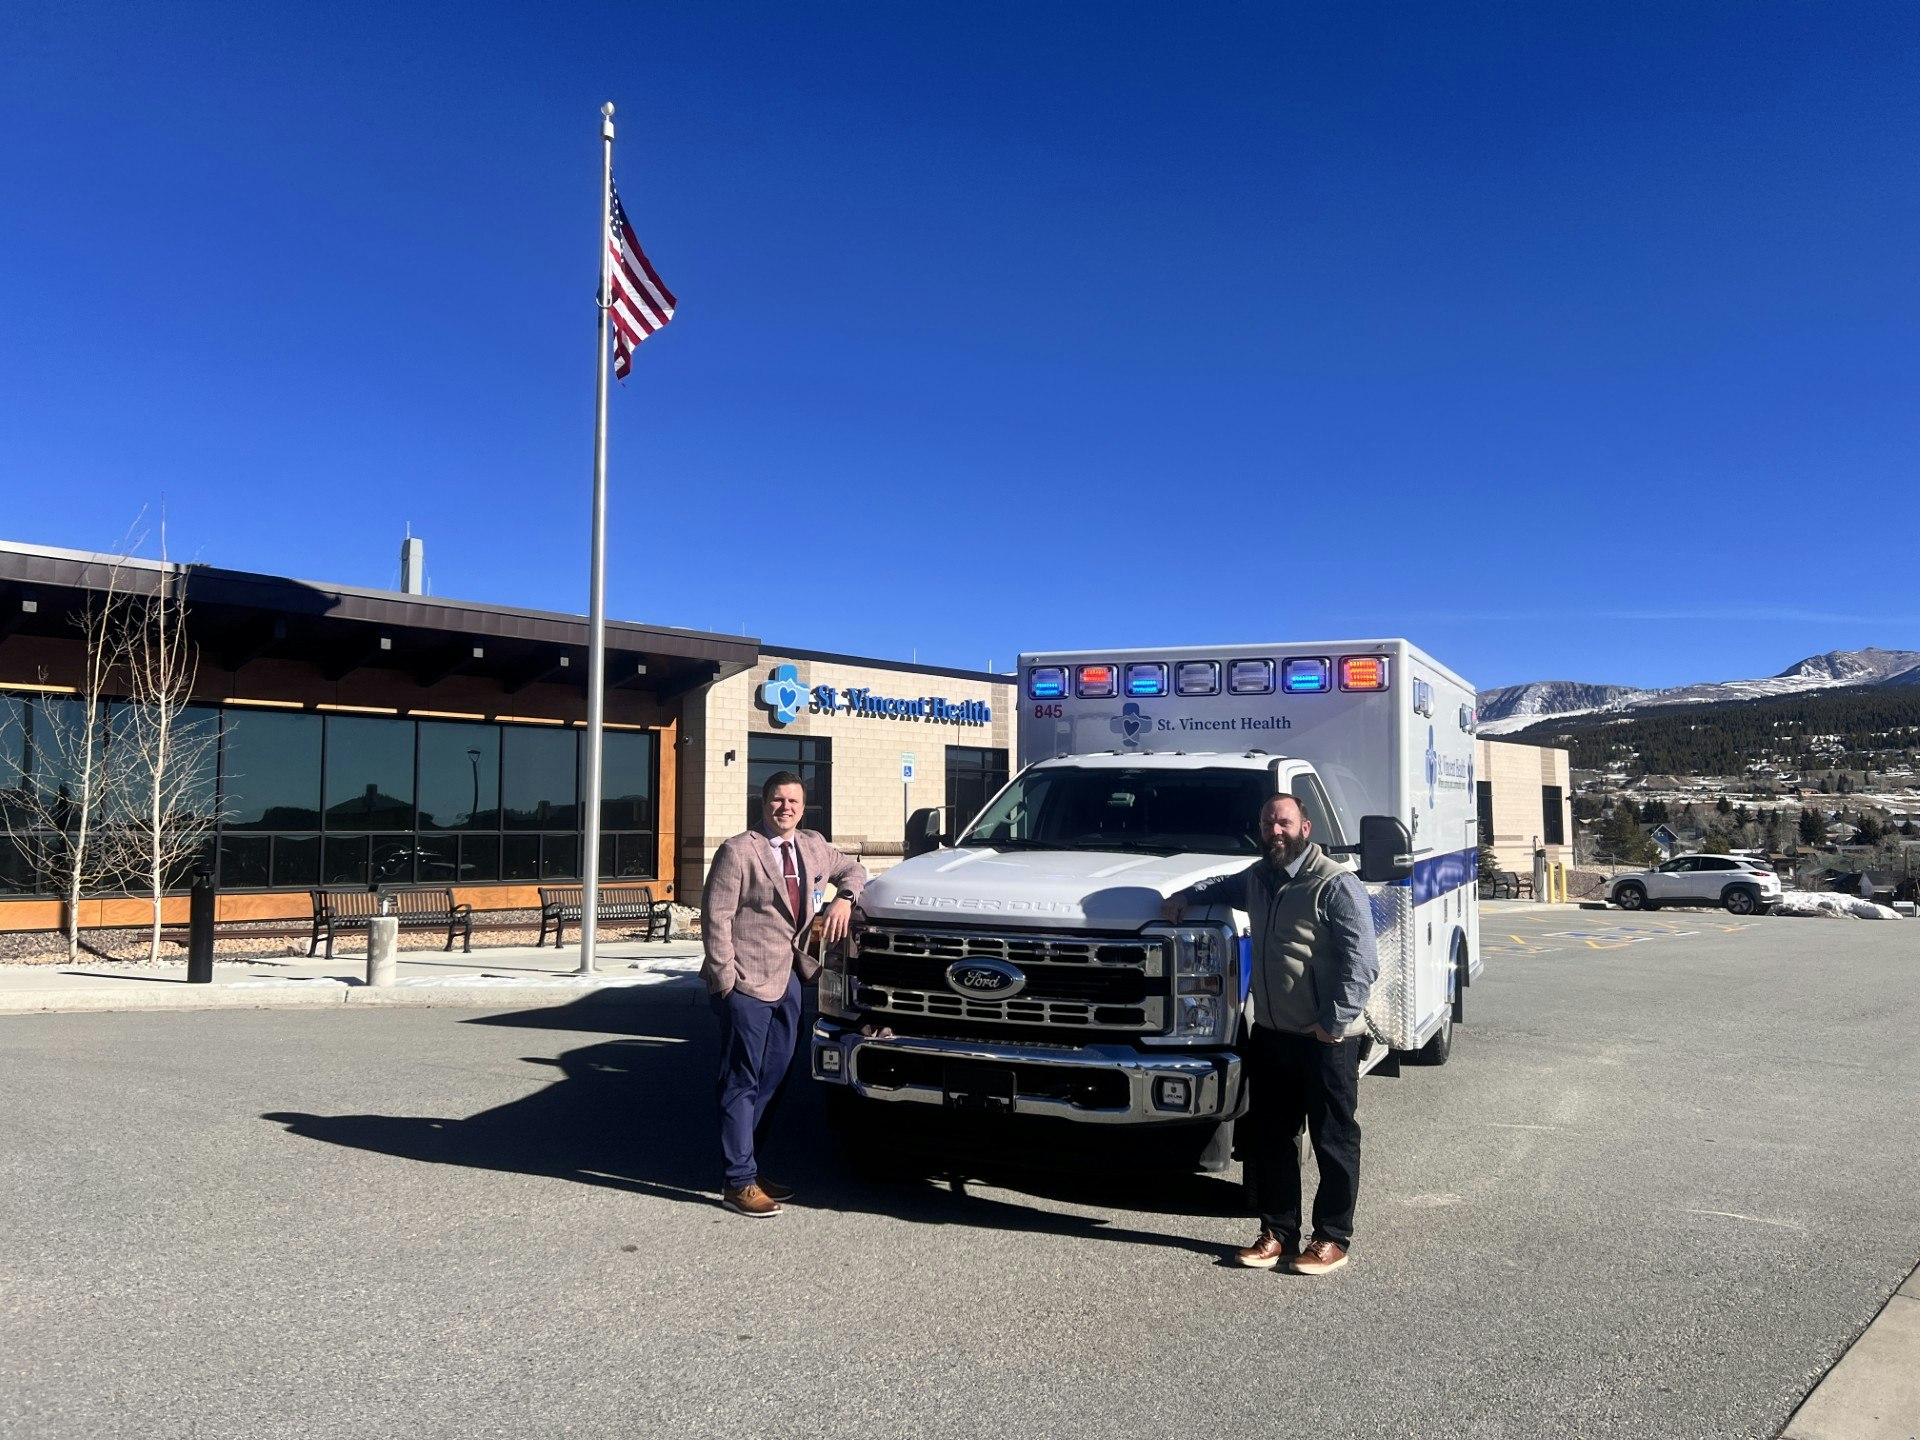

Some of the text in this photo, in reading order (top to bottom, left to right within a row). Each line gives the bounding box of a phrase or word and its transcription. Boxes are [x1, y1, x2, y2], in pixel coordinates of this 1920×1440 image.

[818, 684, 992, 723] St. Vincent Health
[1034, 704, 1063, 719] 845
[1157, 716, 1291, 731] St. Vincent Health
[894, 895, 1080, 913] SUPER DUT
[964, 969, 1000, 988] Ford
